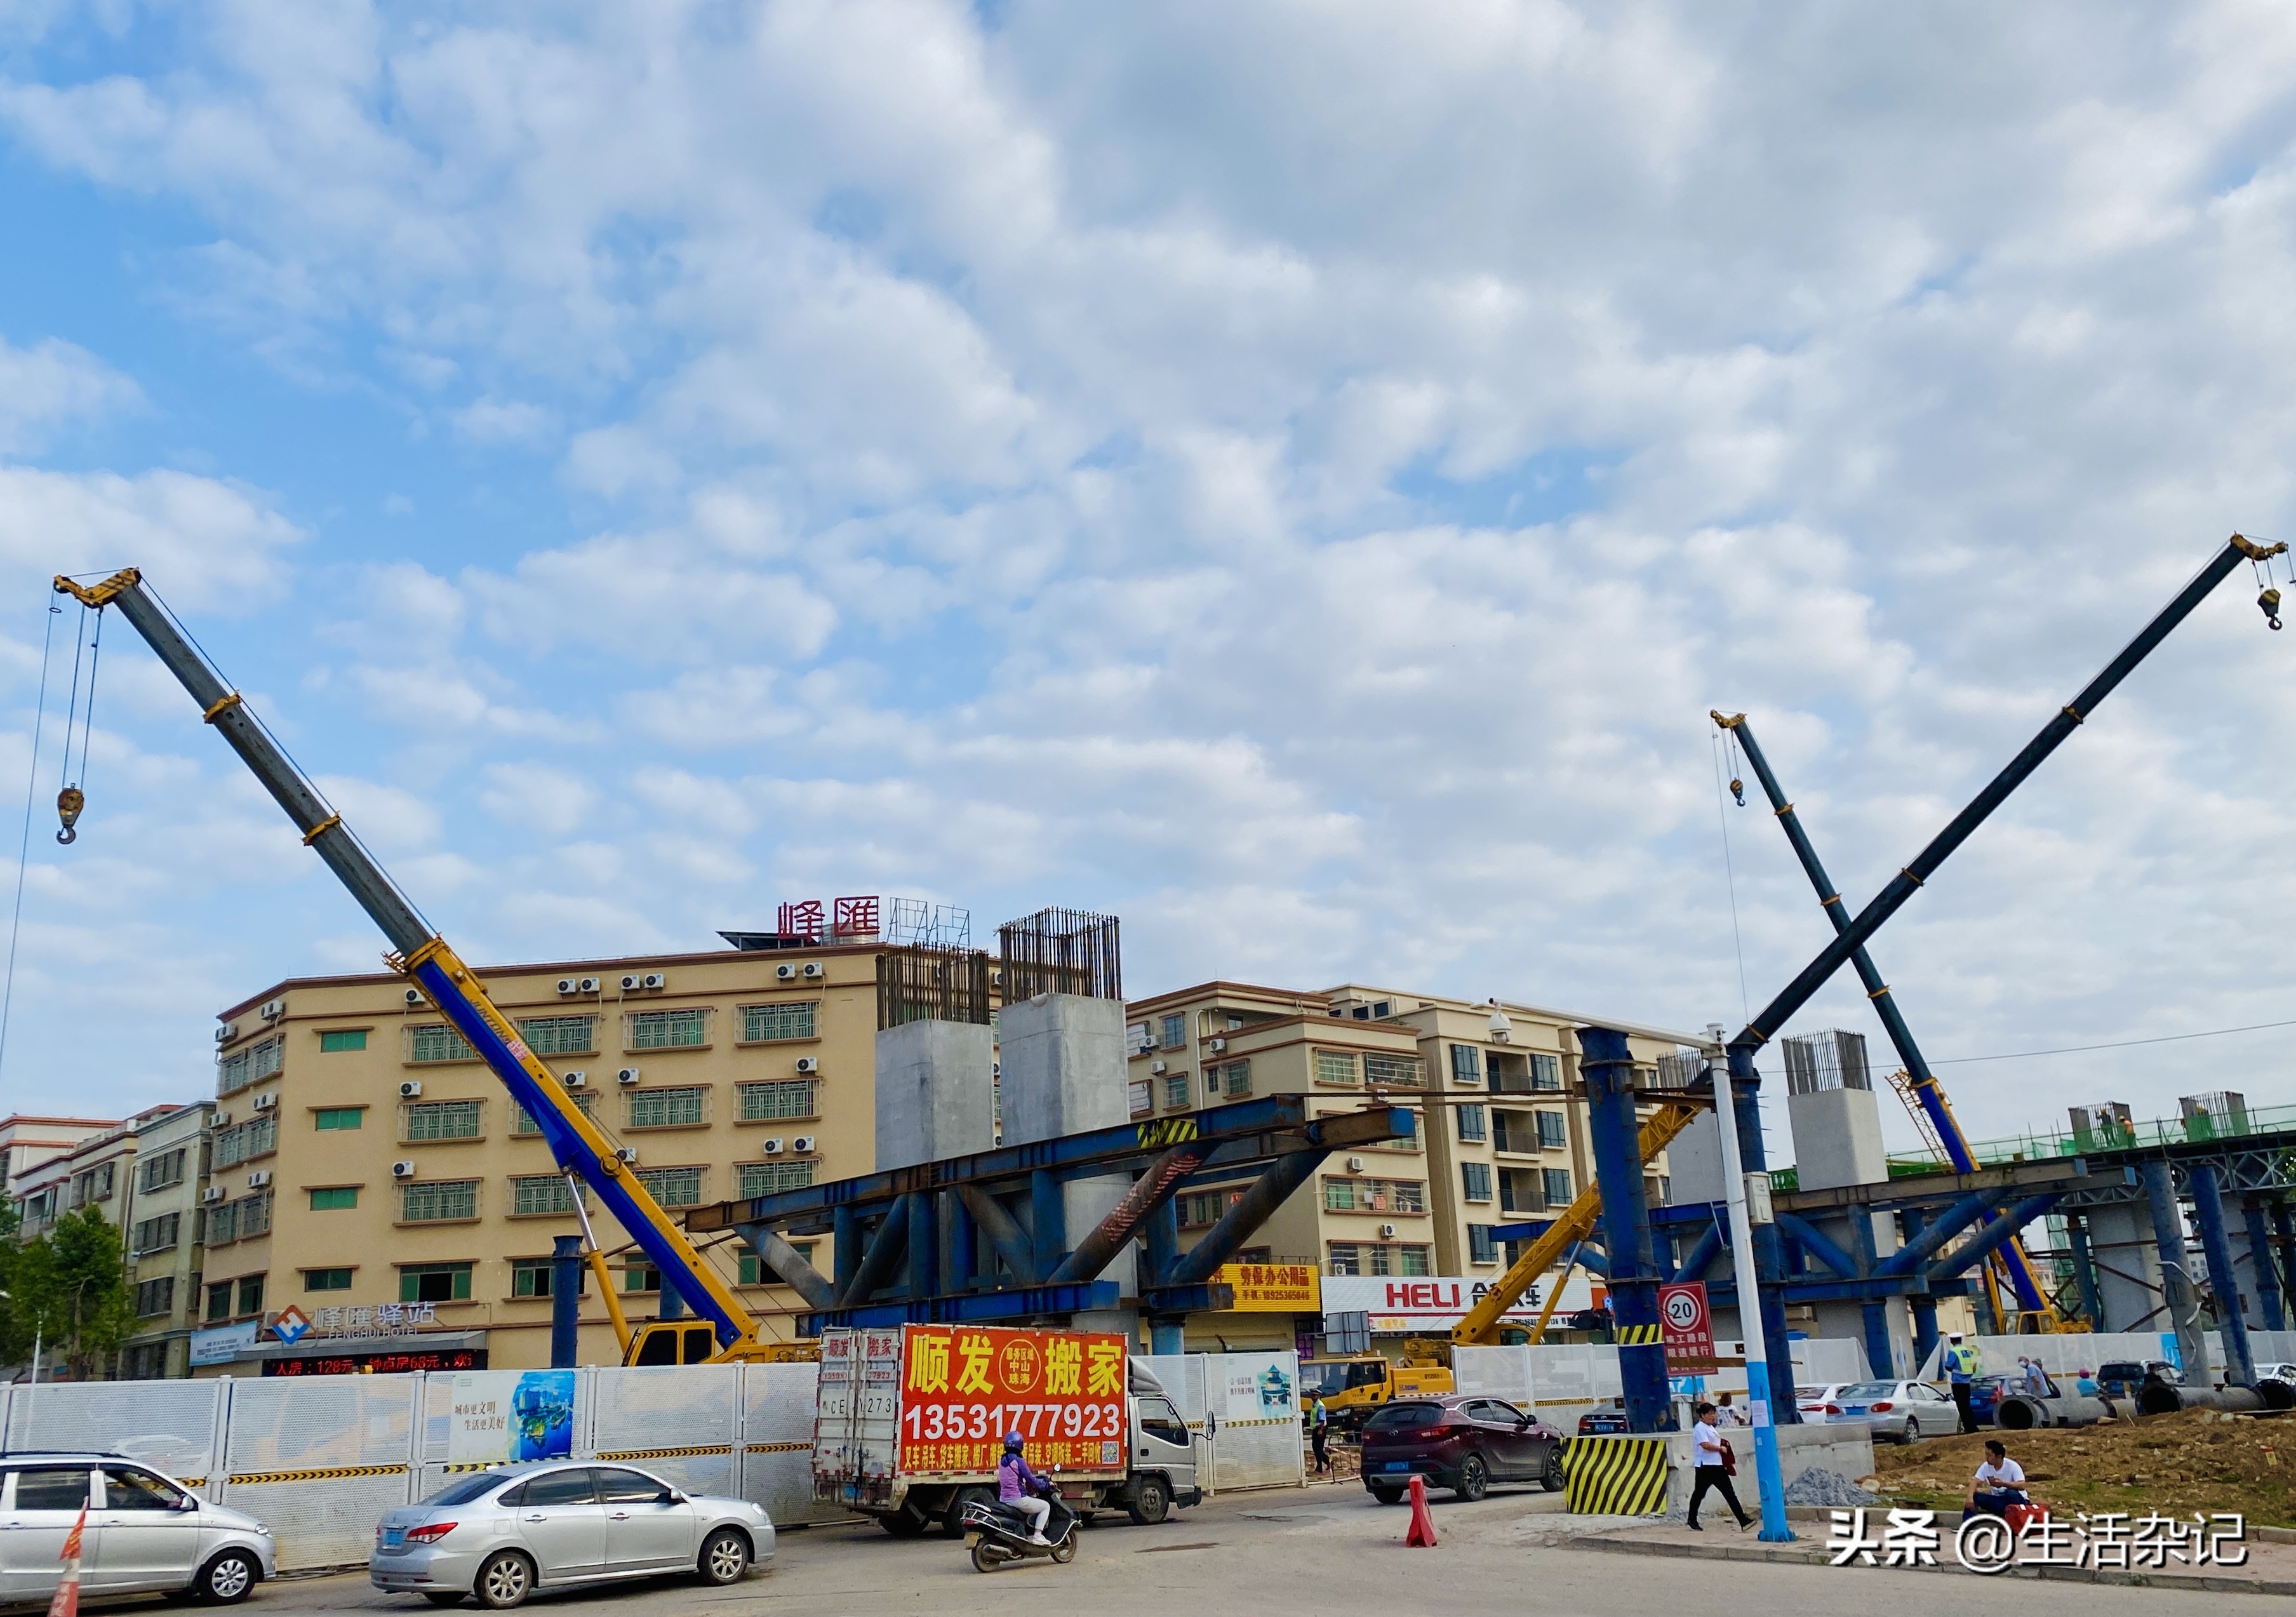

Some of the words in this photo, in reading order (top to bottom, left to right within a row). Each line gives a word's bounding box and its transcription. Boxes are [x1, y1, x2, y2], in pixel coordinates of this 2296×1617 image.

[777, 896, 880, 943] 峰匯
[1240, 1266, 1310, 1286] 劳保办公用品
[1386, 1284, 1460, 1307] HELI
[315, 1301, 436, 1329] 峰匯驿站
[1671, 1303, 1692, 1319] 20
[328, 1329, 380, 1340] FENGHUI
[1665, 1332, 1708, 1343] 施工路段
[867, 1336, 892, 1356] 搬家
[1006, 1347, 1034, 1361] 服务区域
[271, 1357, 354, 1376] 人房：128元
[908, 1333, 994, 1395] 顺发
[1045, 1338, 1122, 1397] 搬家
[1010, 1360, 1030, 1372] 中山
[1009, 1373, 1031, 1385] 珠海
[455, 1401, 495, 1416] 城市更文明
[464, 1416, 505, 1431] 生活更美好
[905, 1404, 1120, 1439] 13531777923
